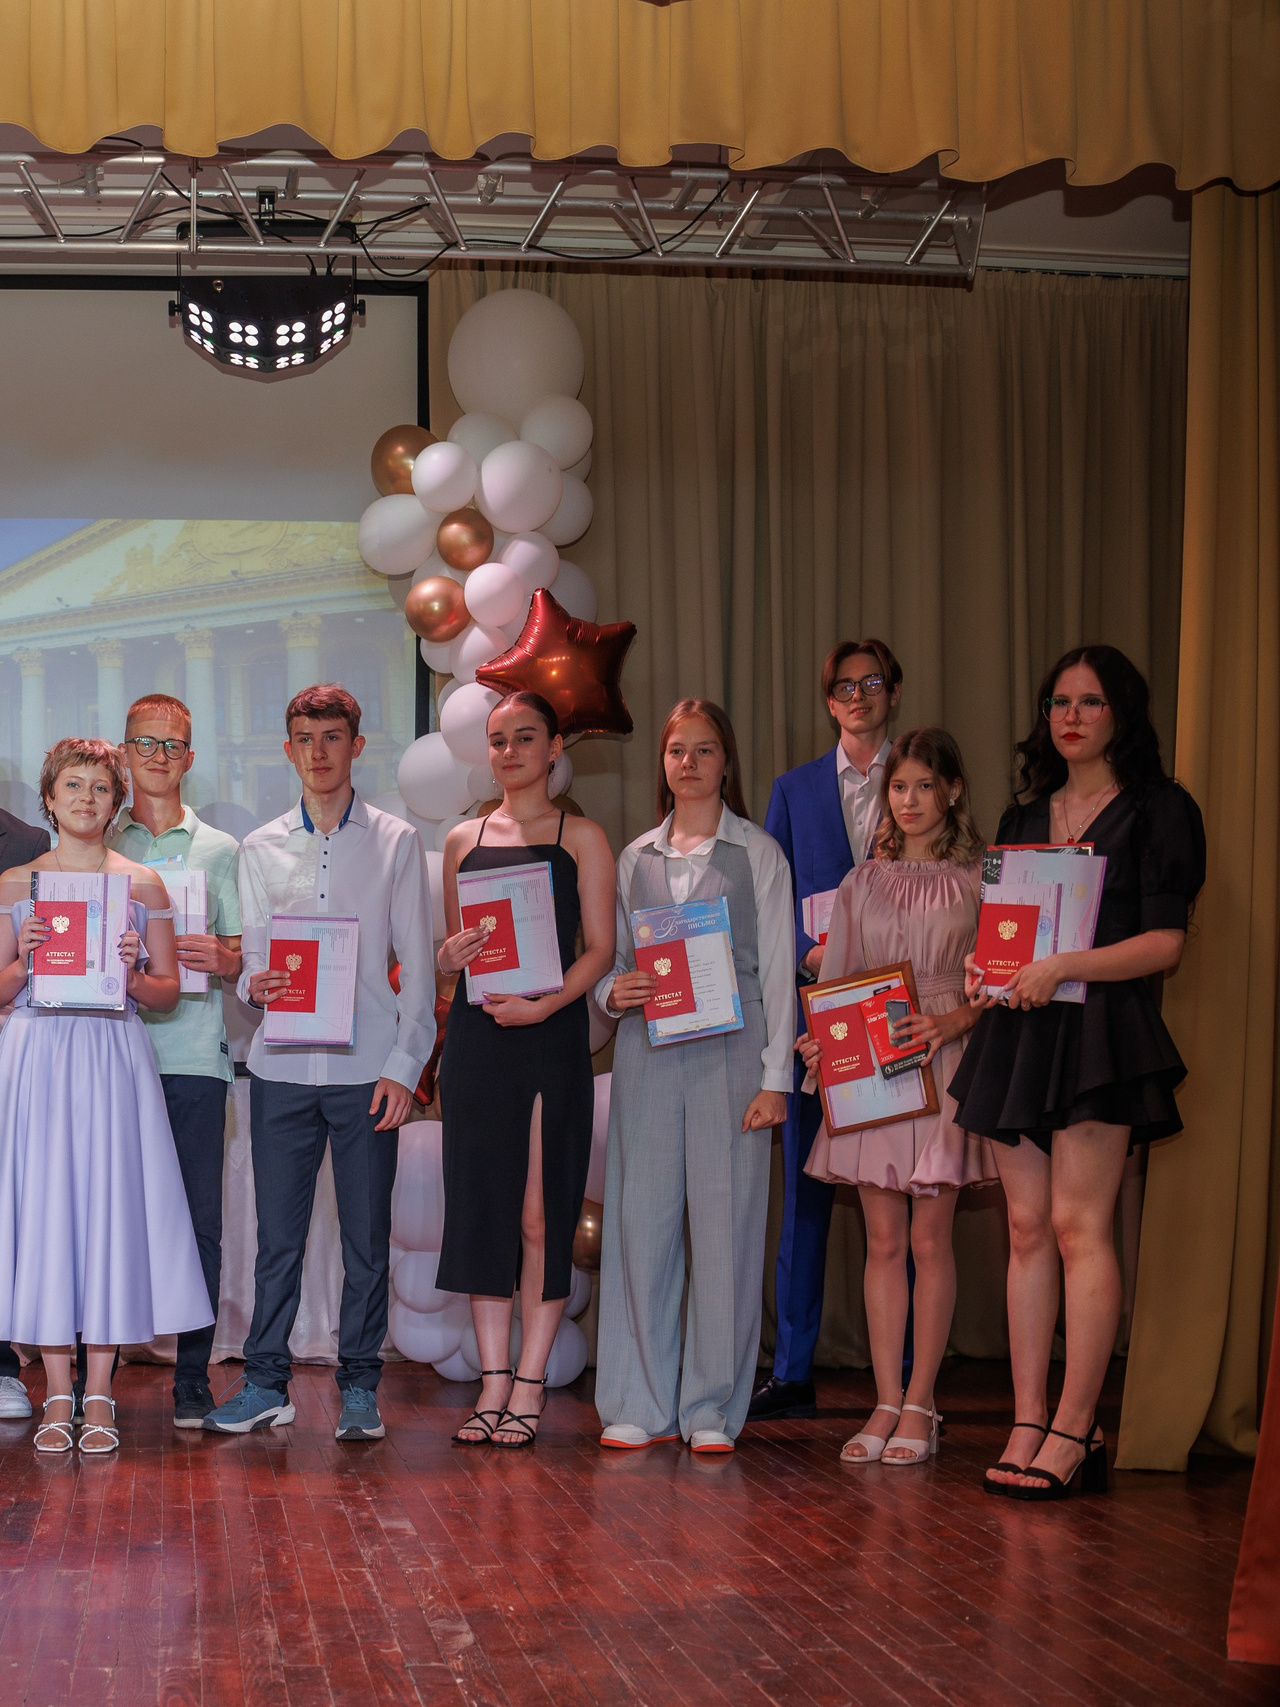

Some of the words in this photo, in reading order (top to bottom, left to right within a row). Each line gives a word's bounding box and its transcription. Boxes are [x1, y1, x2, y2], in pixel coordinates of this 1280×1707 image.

[654, 912, 721, 938] Благодарственное
[687, 919, 716, 930] ПИСЬМО
[479, 947, 507, 957] АТТЕСТАТ
[654, 991, 682, 1002] АТТЕСТАТ
[831, 1054, 860, 1067] АТТЕСТАТ
